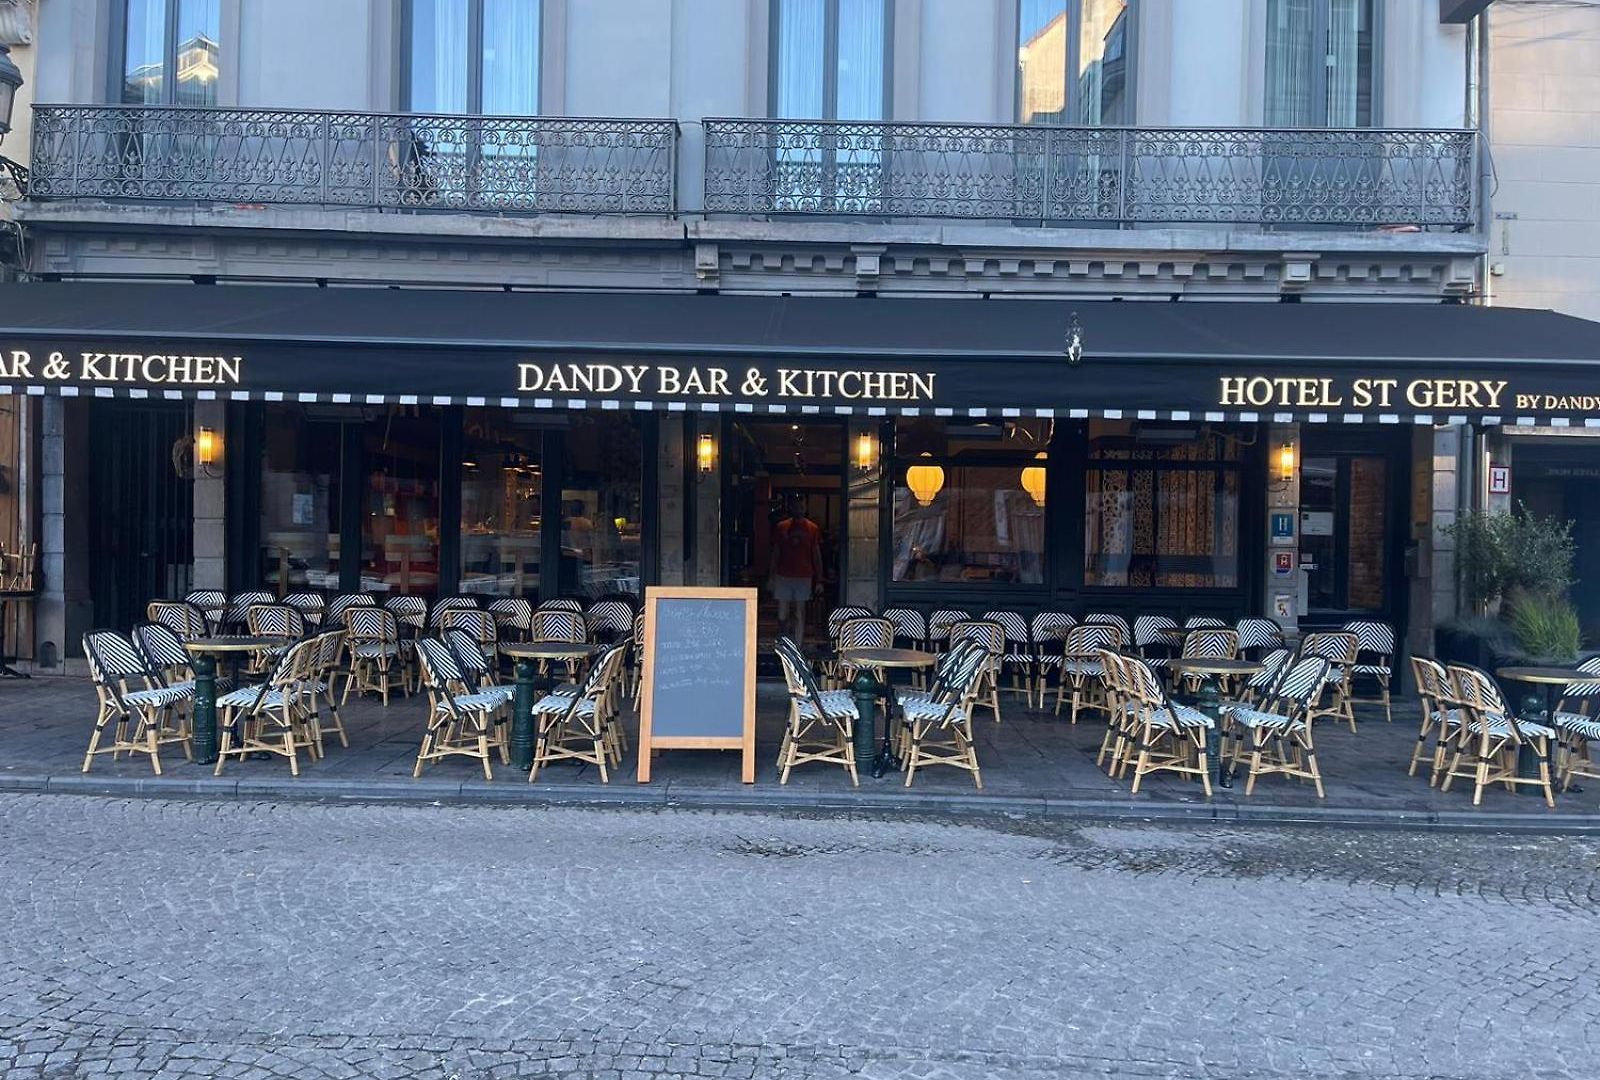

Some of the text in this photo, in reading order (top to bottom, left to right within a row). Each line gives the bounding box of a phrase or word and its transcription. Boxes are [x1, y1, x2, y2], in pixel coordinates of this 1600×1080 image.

[42, 352, 71, 379] &
[80, 353, 243, 384] KITCHEN
[518, 364, 937, 399] DANDY BAR & KITCHEN
[1219, 377, 1343, 407] HOTEL
[1353, 379, 1398, 407] ST
[1406, 379, 1508, 408] GERY
[1516, 394, 1541, 409] BY
[1493, 470, 1506, 488] H
